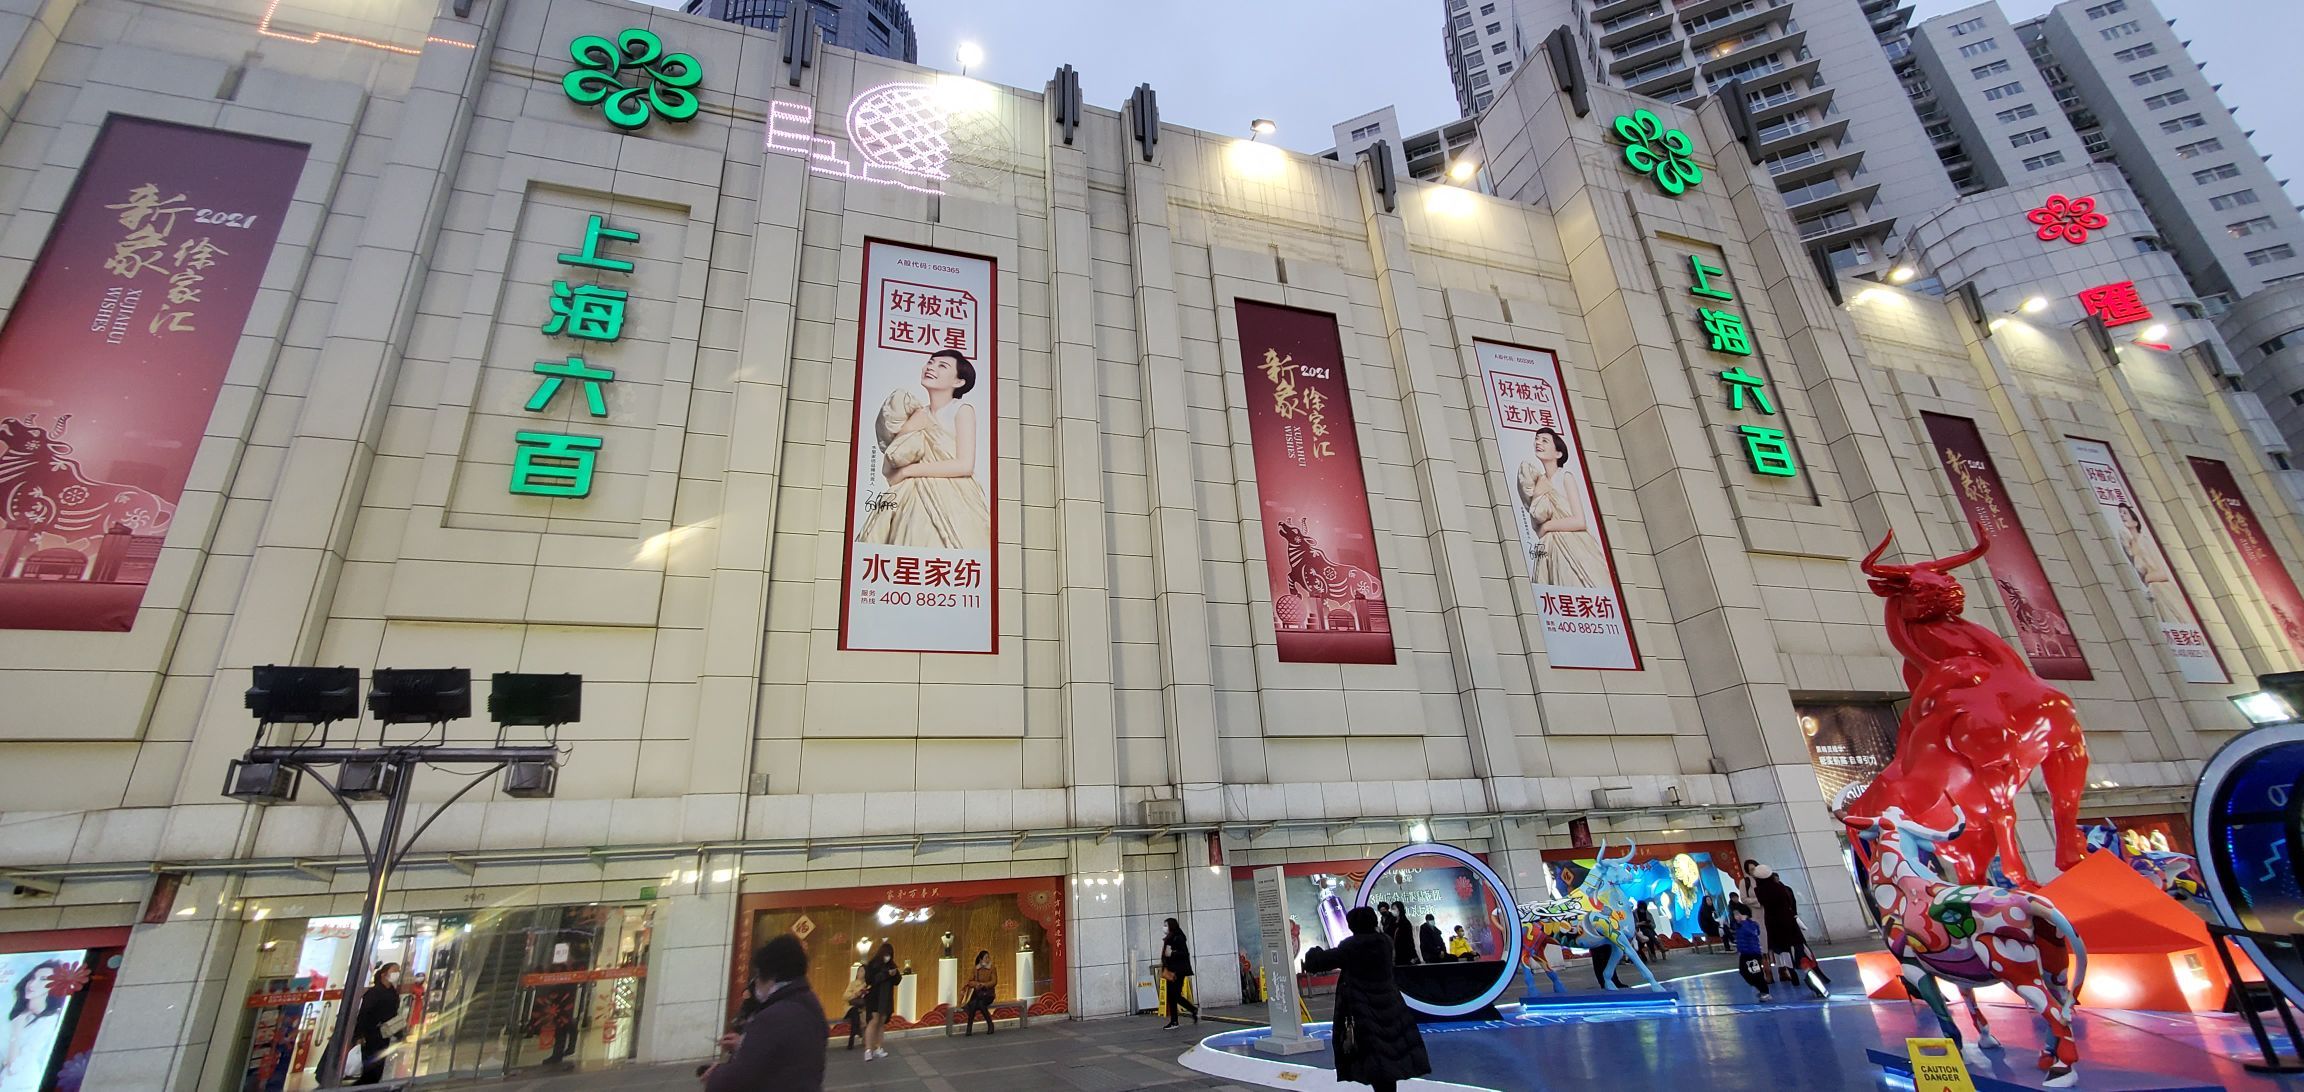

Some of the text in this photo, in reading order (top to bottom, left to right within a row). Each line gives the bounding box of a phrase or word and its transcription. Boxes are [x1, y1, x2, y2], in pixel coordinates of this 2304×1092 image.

[194, 208, 257, 229] 2021
[149, 237, 229, 333] 徐家汇
[91, 287, 123, 332] WISHES
[107, 288, 142, 344] XUJIAHUI
[891, 289, 968, 320] 好被芯
[889, 320, 967, 350] 选水星
[509, 214, 640, 499] 上海六百
[1689, 255, 1796, 477] 上海六百
[1301, 365, 1330, 379] 2021
[1498, 379, 1549, 402] 好被芯
[1303, 386, 1335, 458] 徐家汇
[1503, 405, 1556, 427] 选水星
[1284, 425, 1295, 458] WISHES
[1294, 426, 1307, 467] XUJIAHUI
[862, 554, 981, 588] 水星家纺
[880, 591, 980, 608] 400 8825 111
[1540, 592, 1615, 619] 水星家纺
[1558, 621, 1576, 633] 400
[1578, 623, 1604, 634] 8825
[1921, 1065, 1959, 1074] CAUTION
[1924, 1074, 1960, 1082] DANGER
